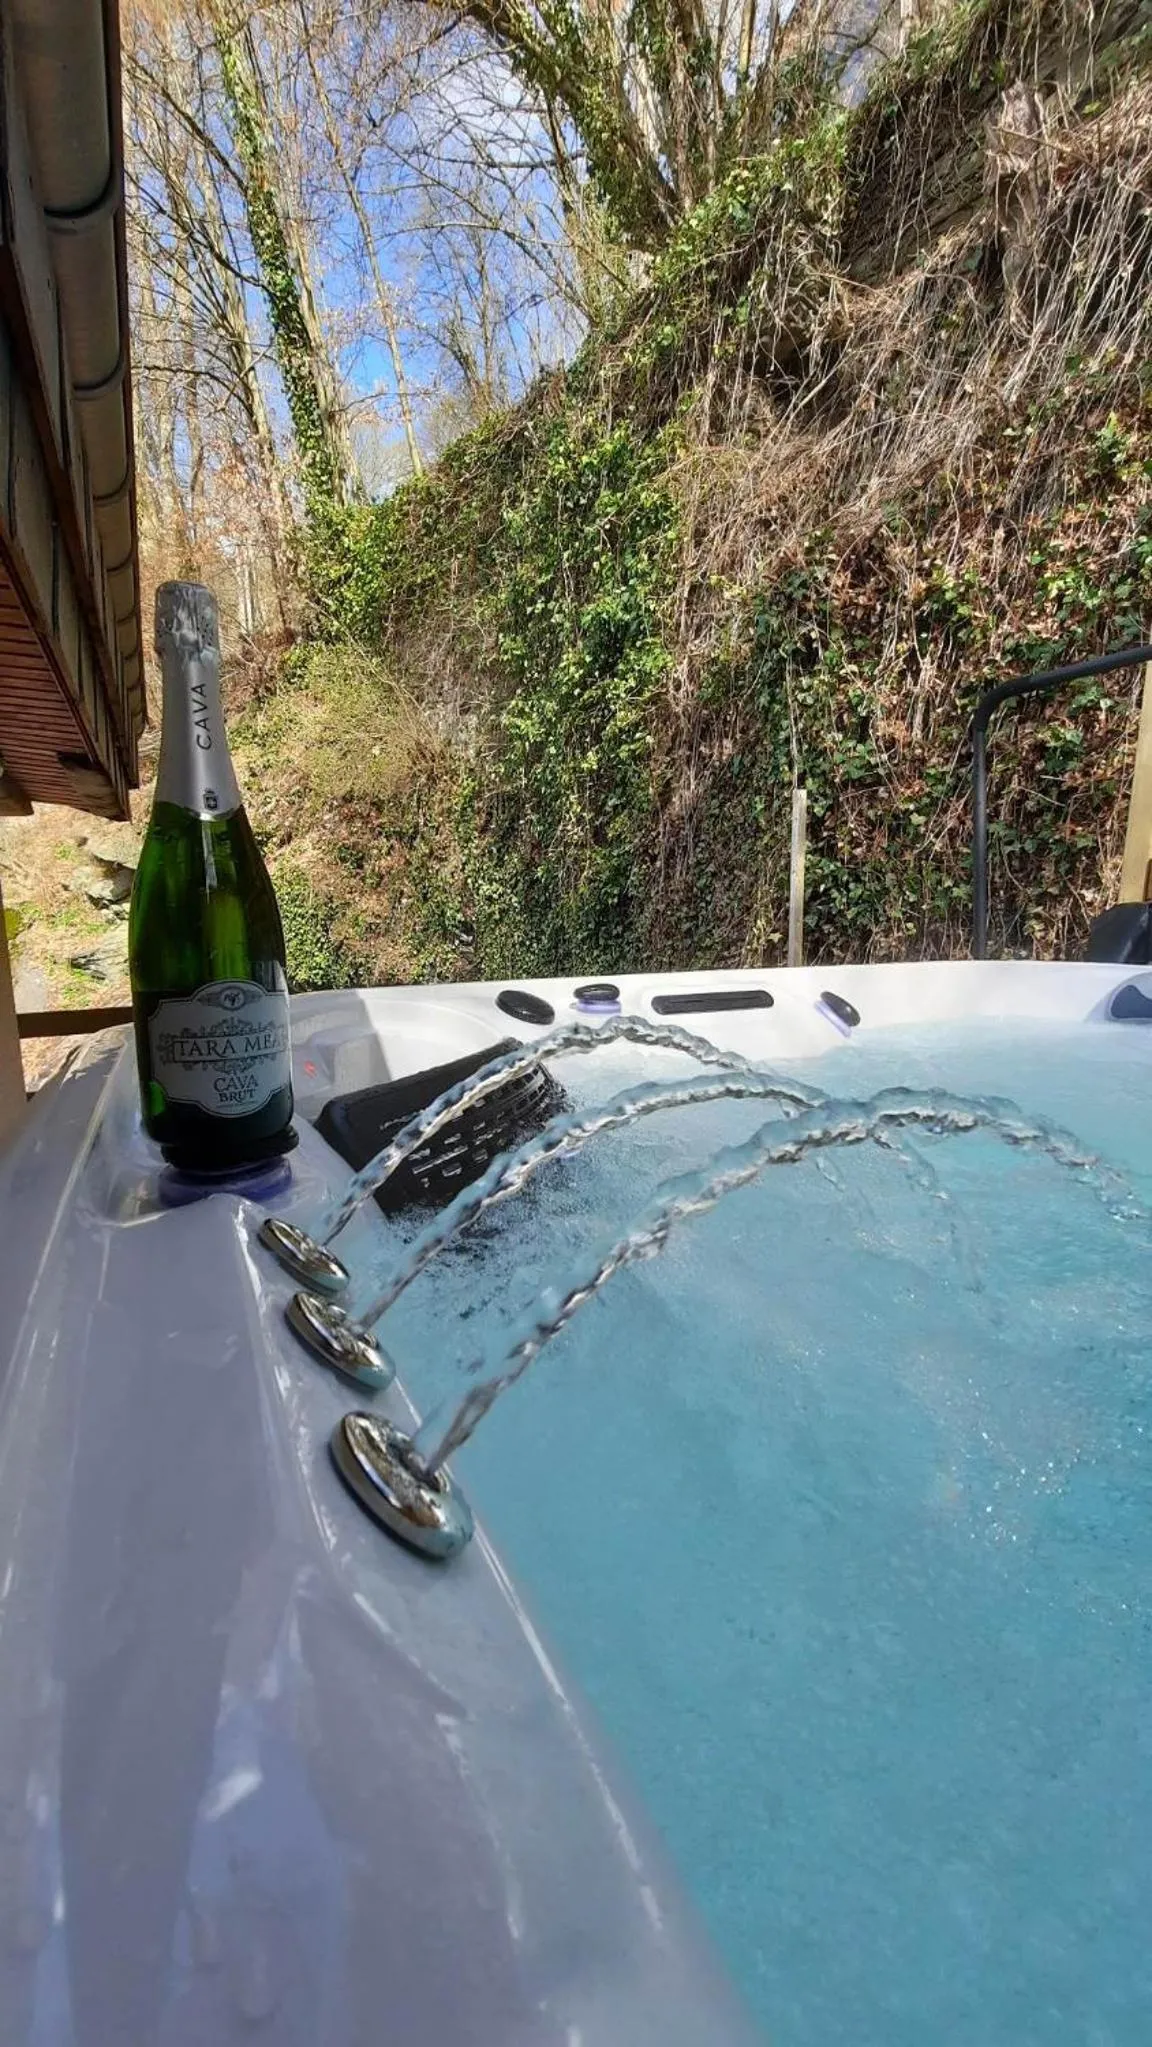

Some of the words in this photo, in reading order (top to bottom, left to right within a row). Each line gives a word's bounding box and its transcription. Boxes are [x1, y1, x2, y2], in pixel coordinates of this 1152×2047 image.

[191, 683, 212, 750] CAVA
[178, 1038, 236, 1058] TARA
[213, 1074, 259, 1092] CAVA
[219, 1089, 256, 1103] BRUT
